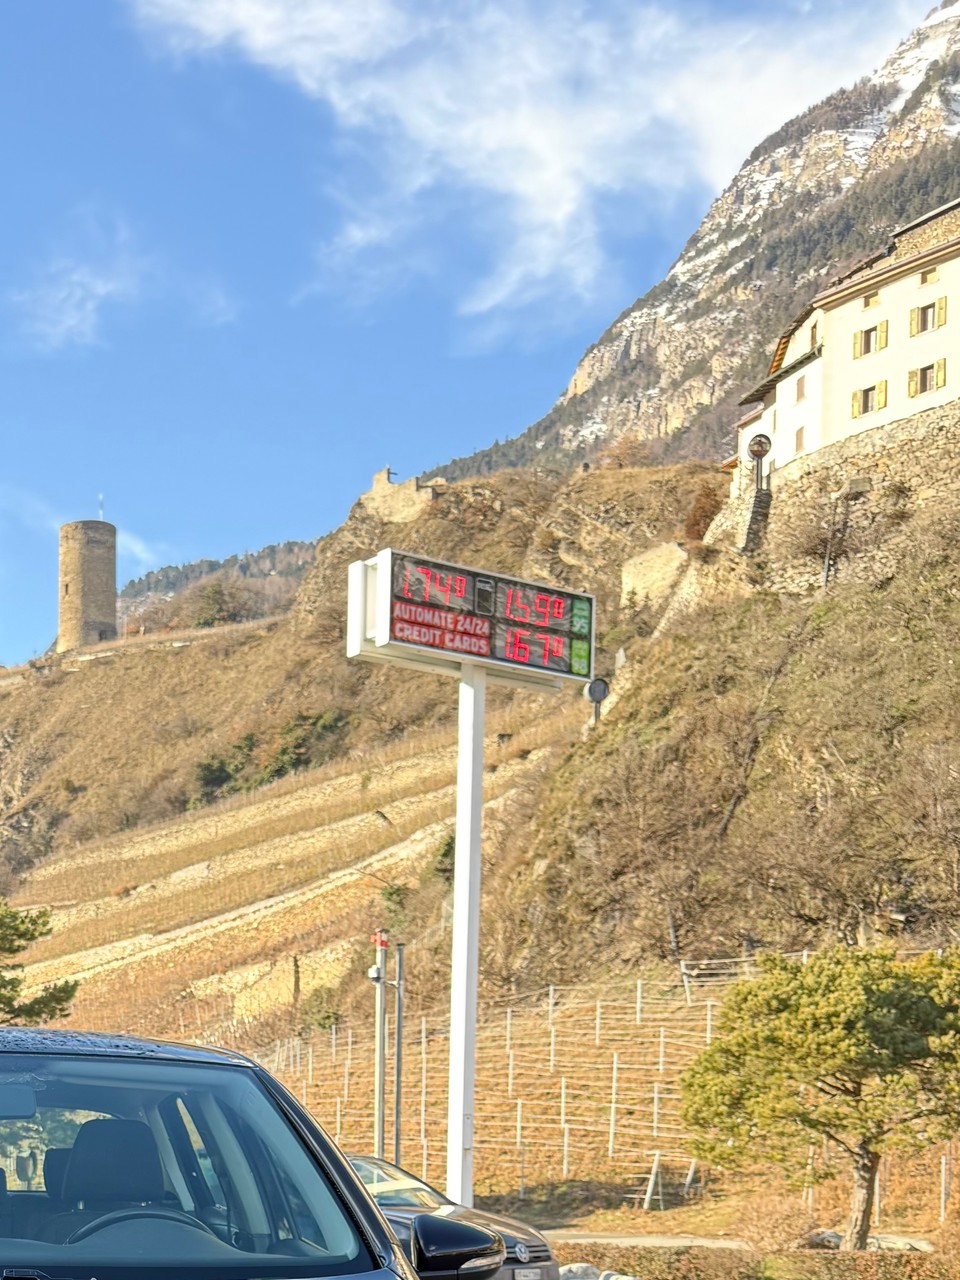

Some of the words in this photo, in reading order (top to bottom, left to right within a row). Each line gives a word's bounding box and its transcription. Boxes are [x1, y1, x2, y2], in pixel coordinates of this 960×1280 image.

[394, 602, 454, 629] AUTOMATE
[456, 614, 490, 635] 24/24
[395, 622, 441, 644] CREDIT
[445, 631, 489, 654] CARDS
